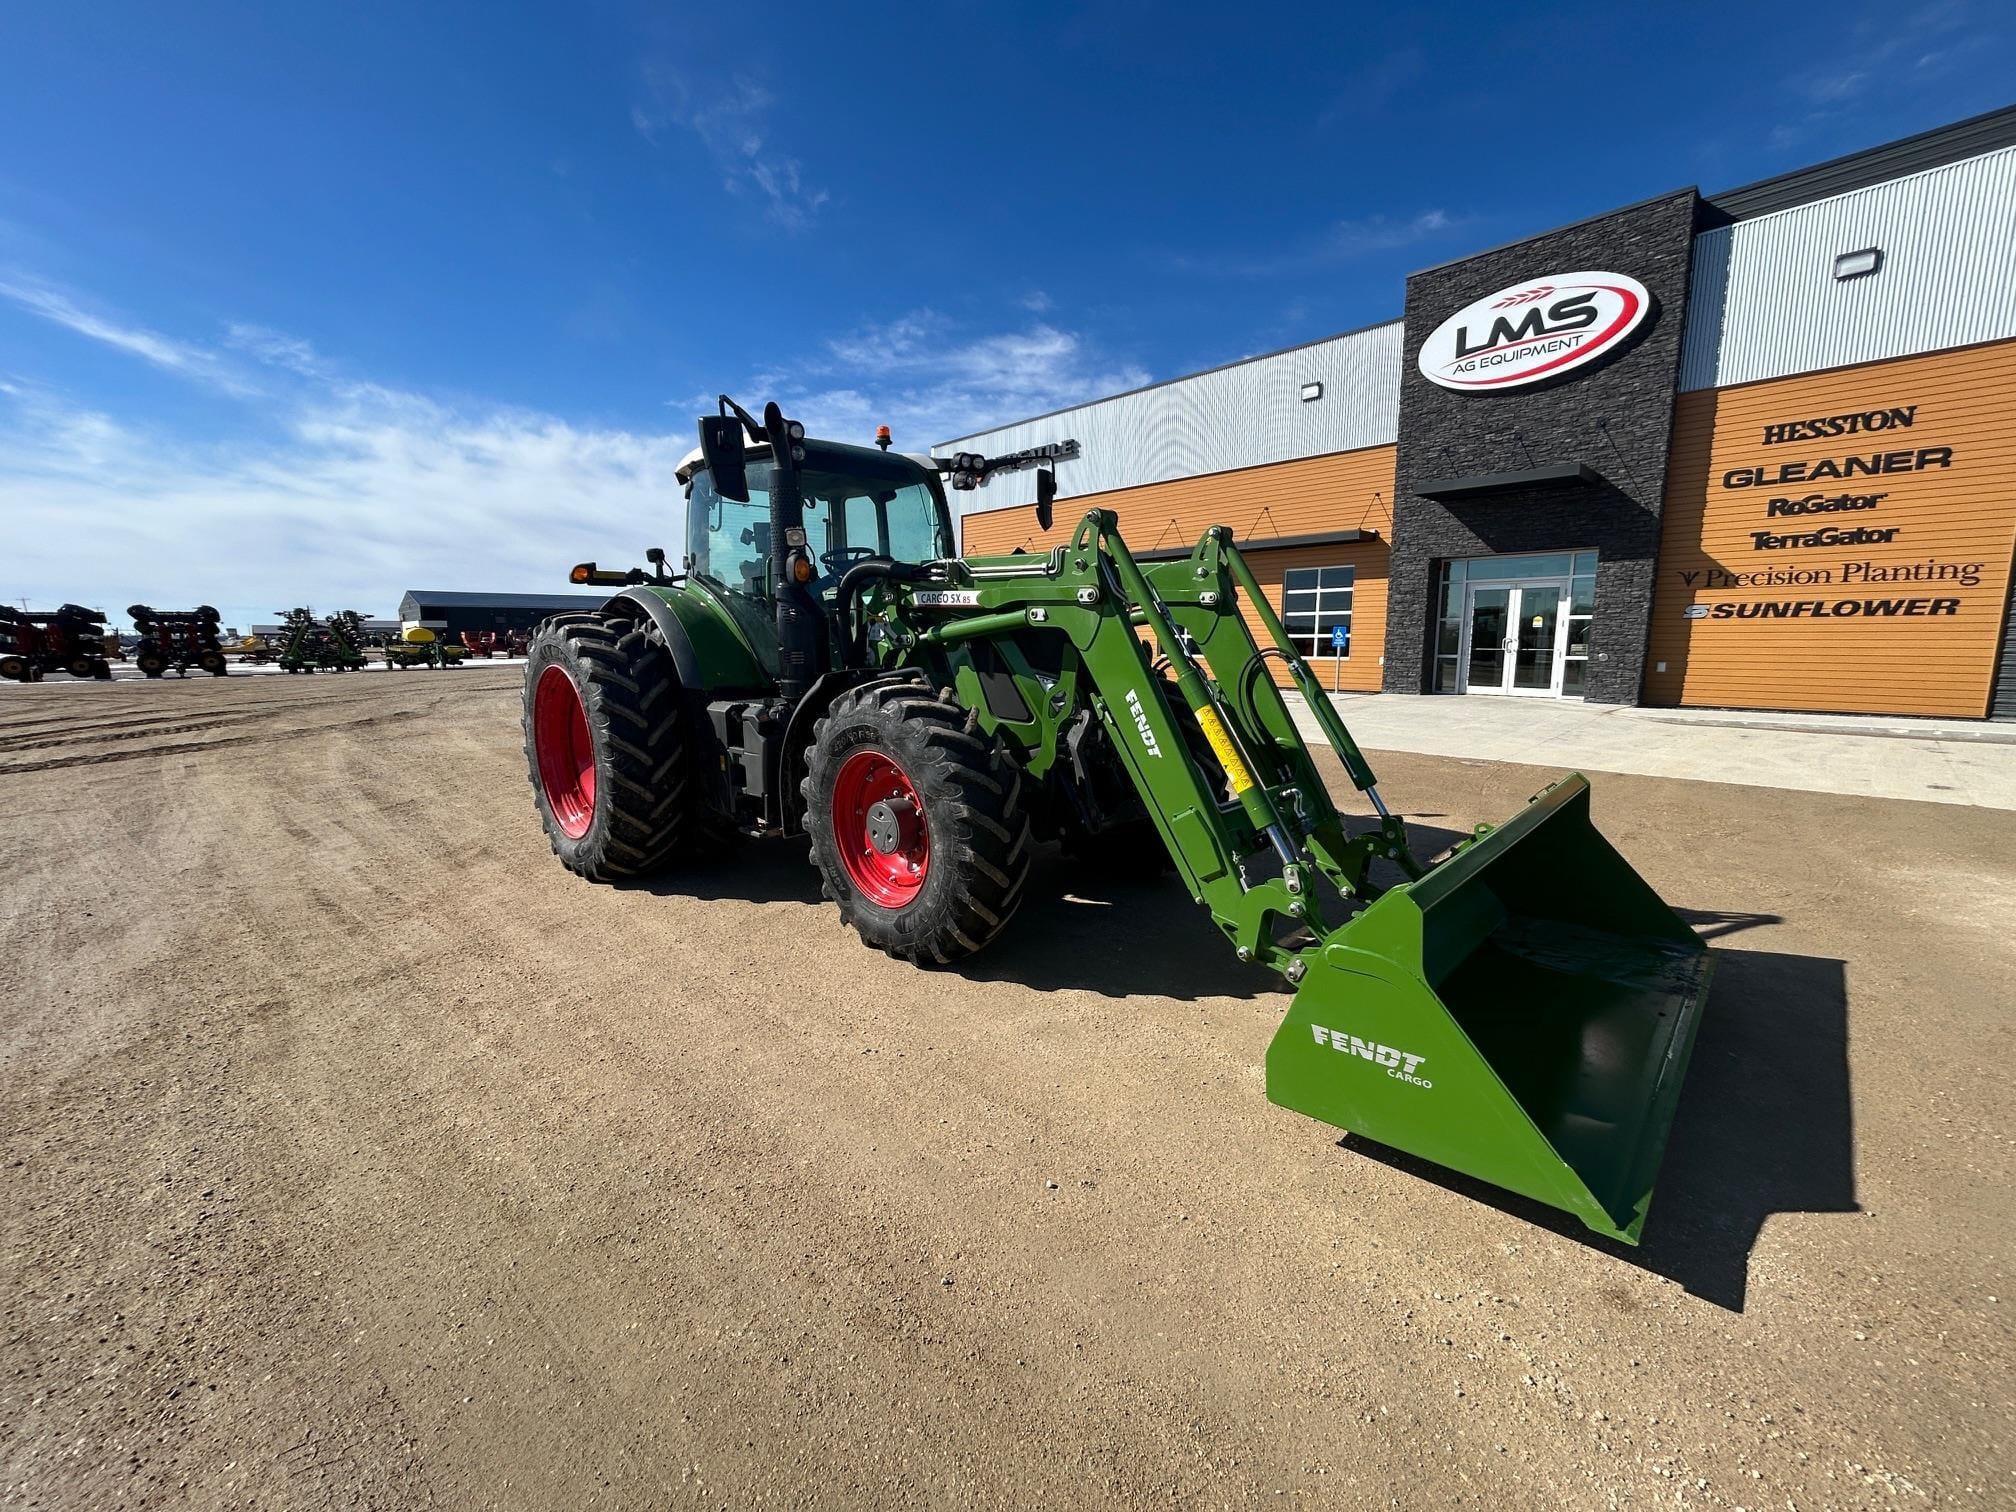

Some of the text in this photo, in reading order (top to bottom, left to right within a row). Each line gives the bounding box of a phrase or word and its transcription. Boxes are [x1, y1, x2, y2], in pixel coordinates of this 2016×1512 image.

[1455, 290, 1599, 359] LMS
[1453, 334, 1584, 375] AG EQUIPMENT
[1762, 405, 1918, 445] HESSTON
[1722, 447, 1953, 489] GLEANER
[1767, 492, 1885, 517] RoGator
[1750, 527, 1900, 550] TerraGator
[1705, 559, 1985, 588] Precision Planting
[920, 593, 971, 604] CARGO SX 85
[1711, 598, 1961, 619] SUNFLOWER
[1124, 688, 1163, 758] FENDT
[1310, 1023, 1426, 1074] FENDT
[1386, 1068, 1433, 1089] CARGO
